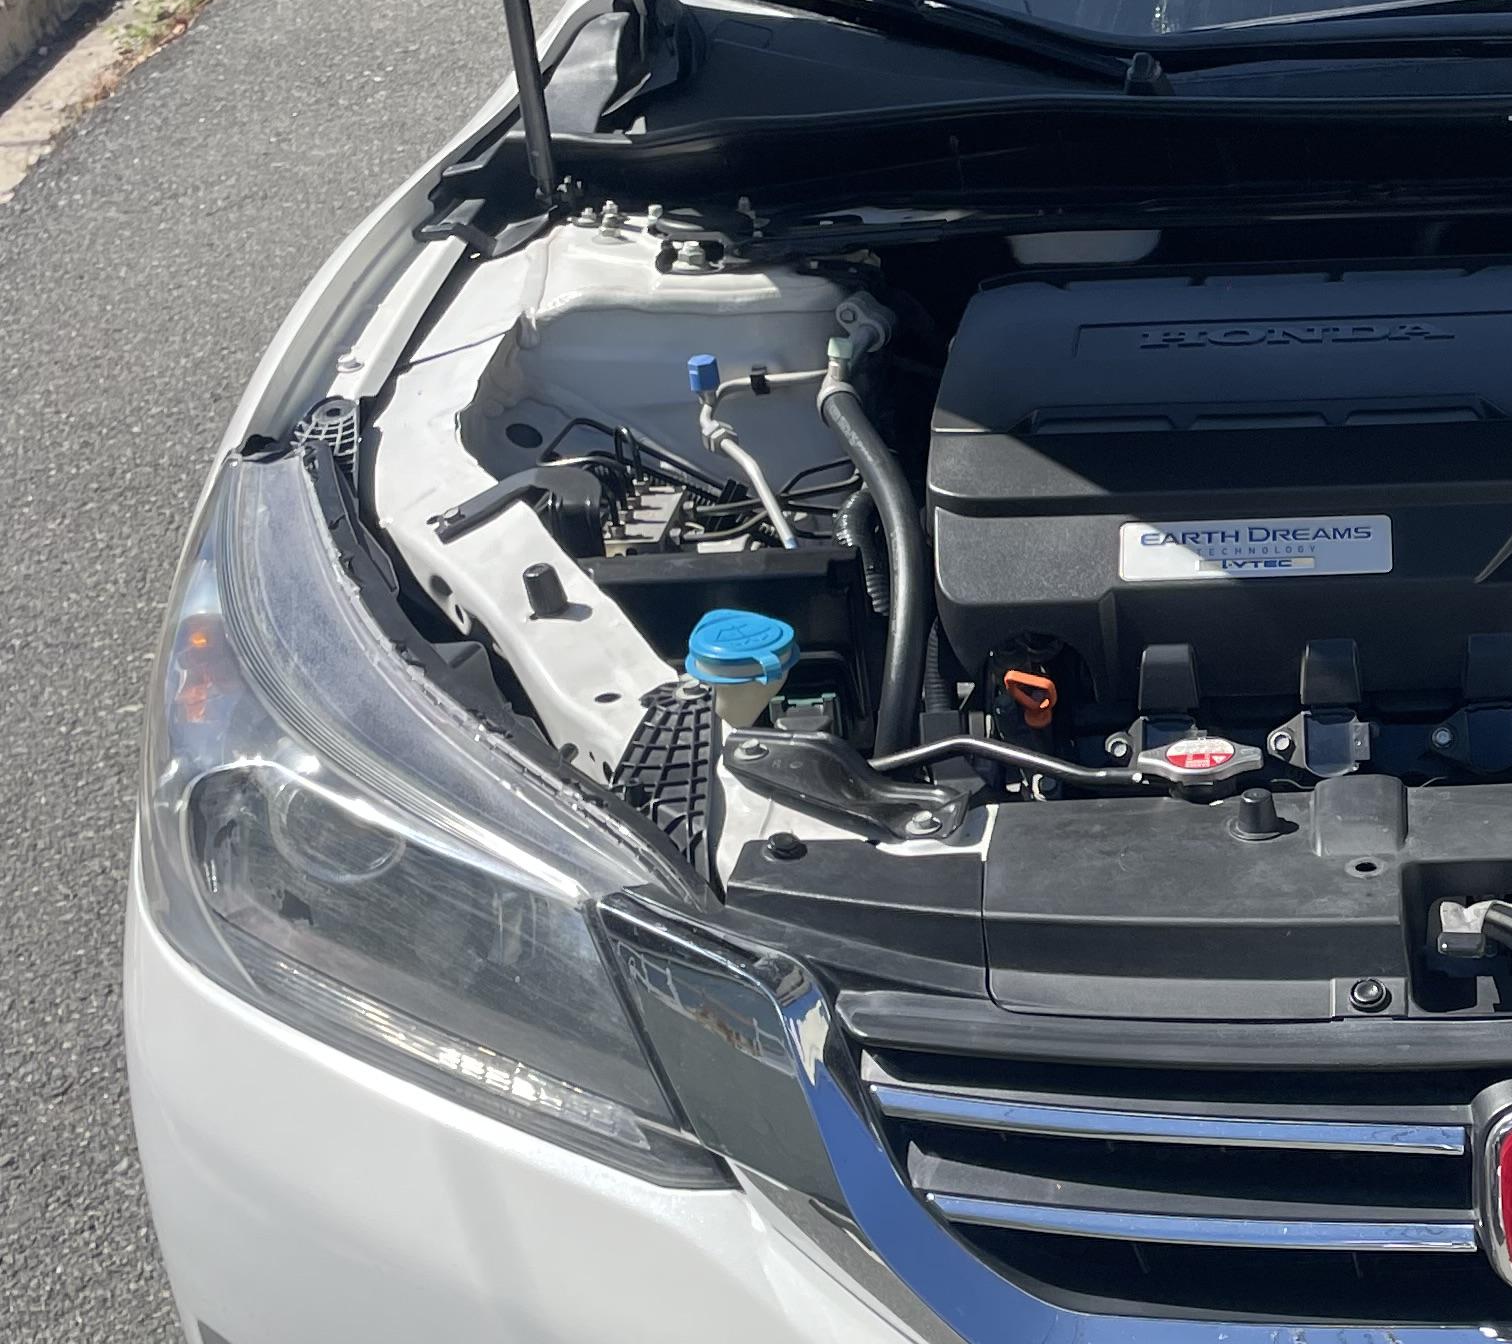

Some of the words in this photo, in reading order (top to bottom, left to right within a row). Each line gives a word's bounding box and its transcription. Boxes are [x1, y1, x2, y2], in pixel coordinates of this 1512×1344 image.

[1139, 322, 1456, 349] HONDA
[1140, 530, 1240, 546] EARTH
[1248, 526, 1372, 543] DREAMS
[1196, 545, 1316, 556] TECHNOLOGY
